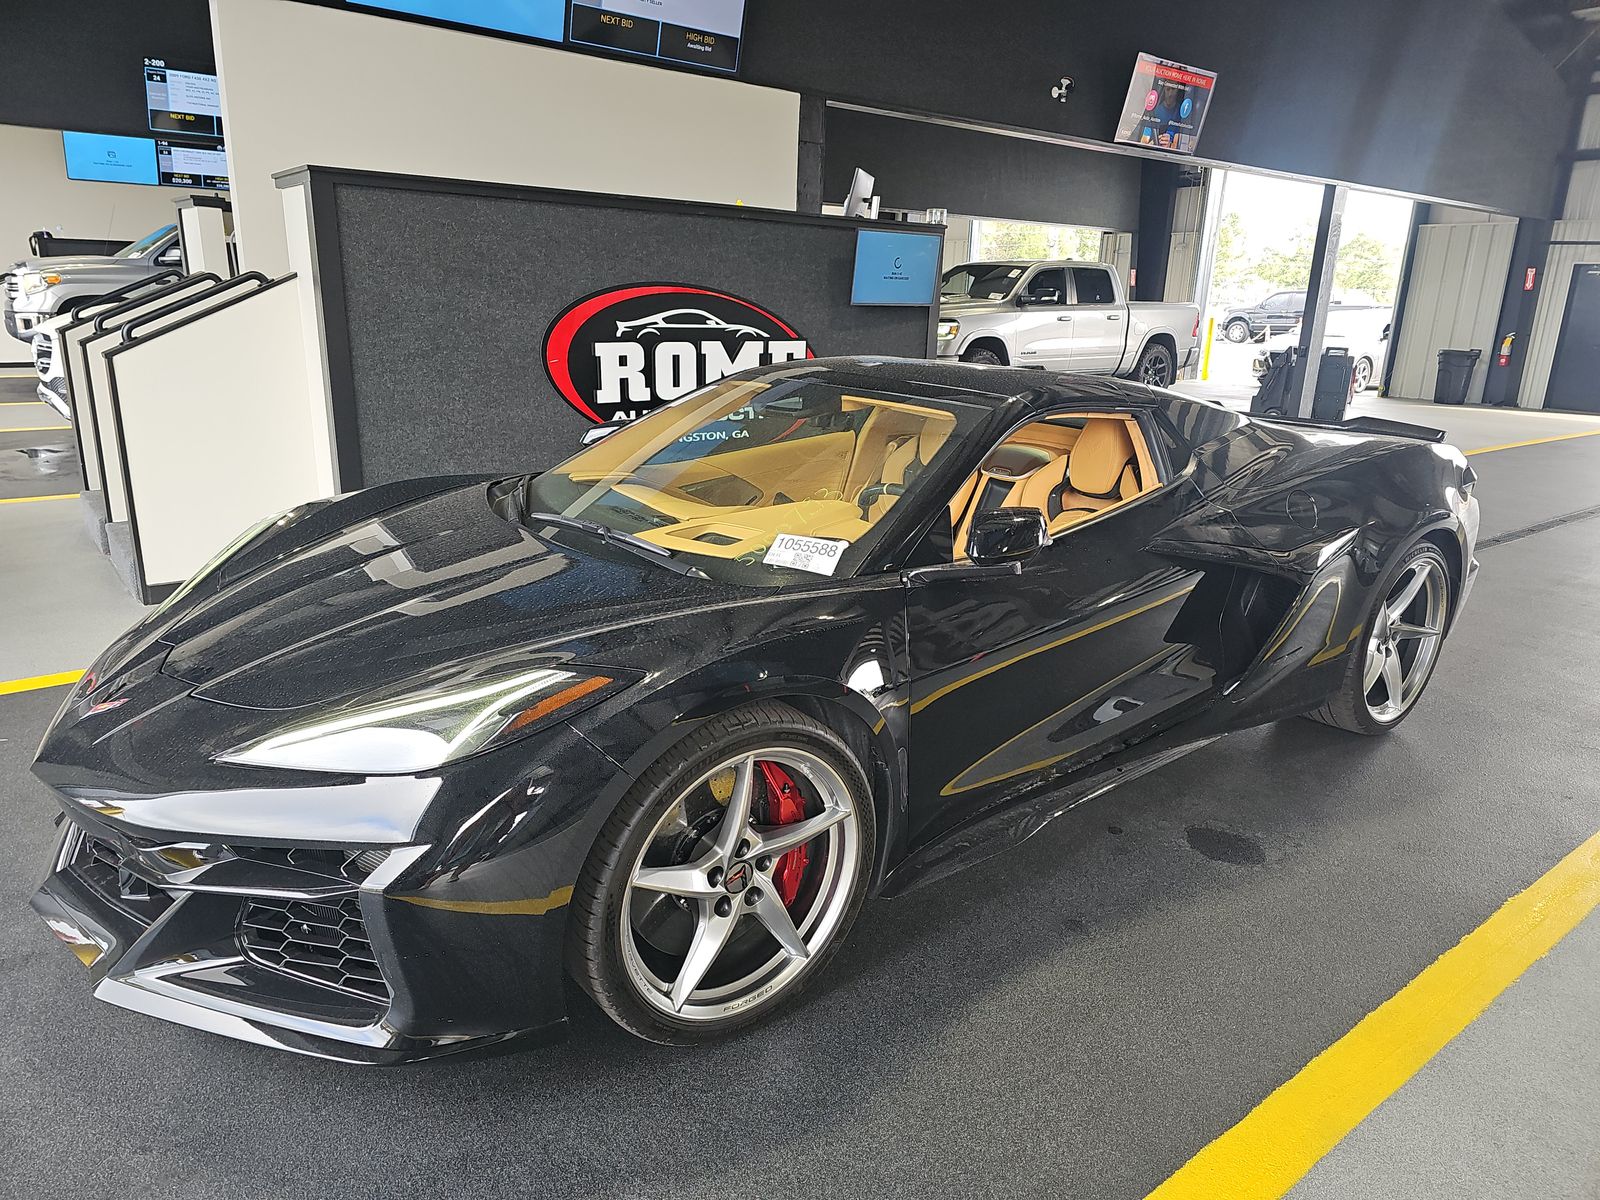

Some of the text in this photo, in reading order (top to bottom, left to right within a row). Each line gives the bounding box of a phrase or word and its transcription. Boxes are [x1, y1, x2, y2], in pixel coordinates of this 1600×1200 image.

[600, 14, 634, 29] NEXT BID
[686, 32, 716, 45] HIGH BID
[687, 42, 705, 52] Awaiting
[143, 58, 165, 67] 2-200
[732, 429, 750, 439] GA
[777, 537, 839, 558] 1055588
[723, 985, 773, 1012] FORGED
